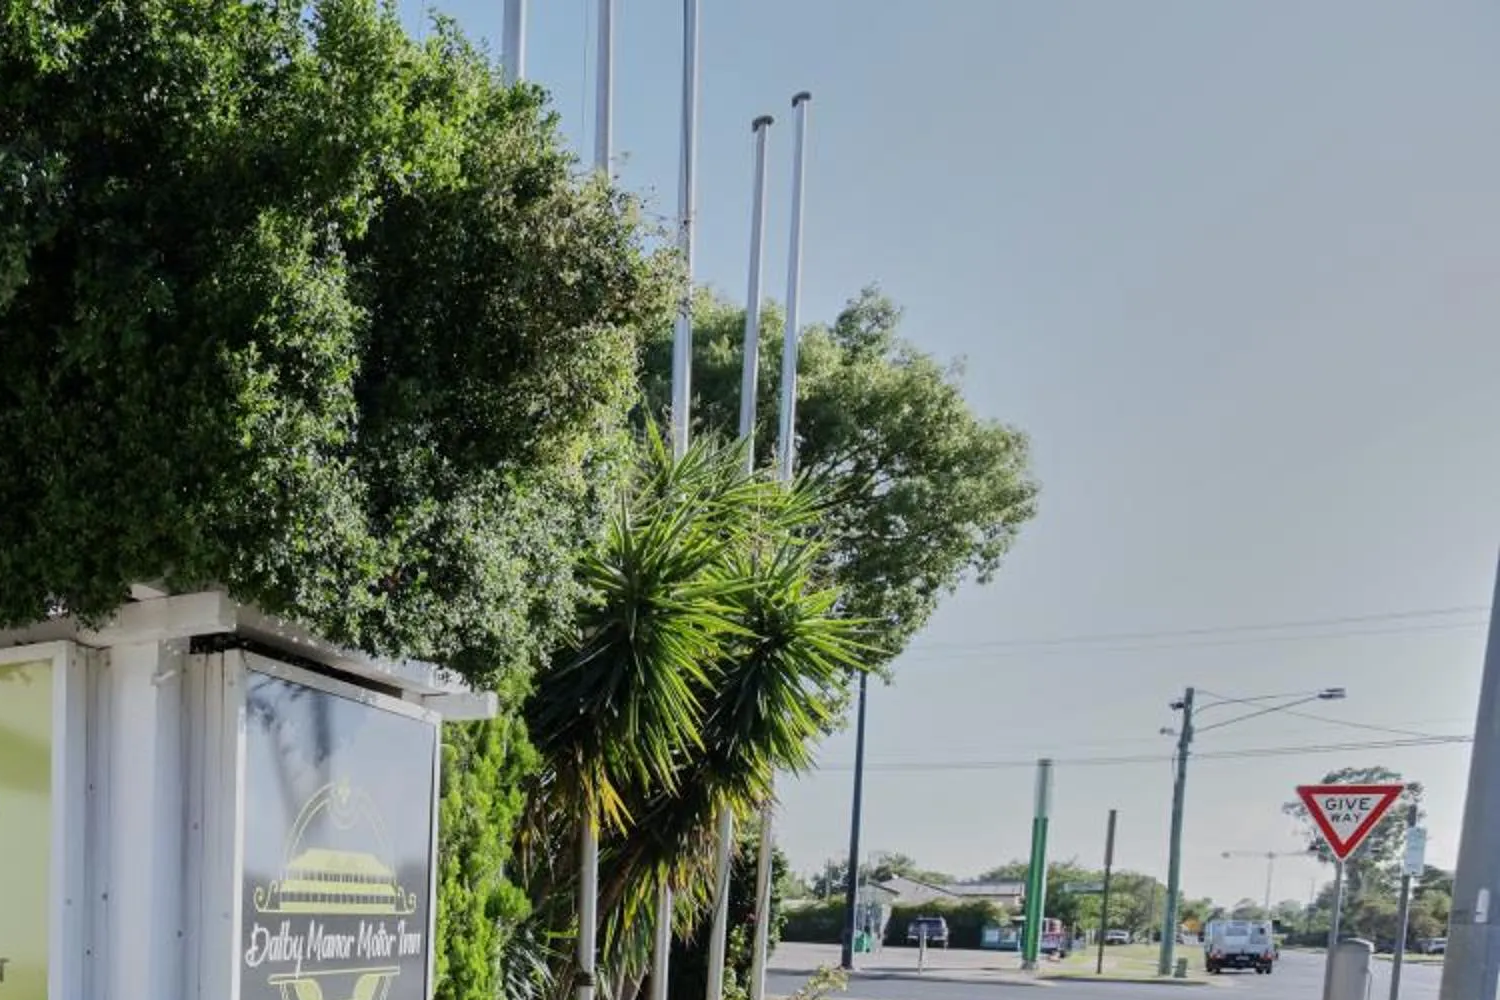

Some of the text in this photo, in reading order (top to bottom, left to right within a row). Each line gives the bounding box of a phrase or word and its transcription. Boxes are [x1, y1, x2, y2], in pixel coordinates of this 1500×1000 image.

[1325, 798, 1371, 811] GIVE
[1331, 813, 1361, 823] WAY
[245, 918, 421, 979] Dalby Manor Motor Inn
